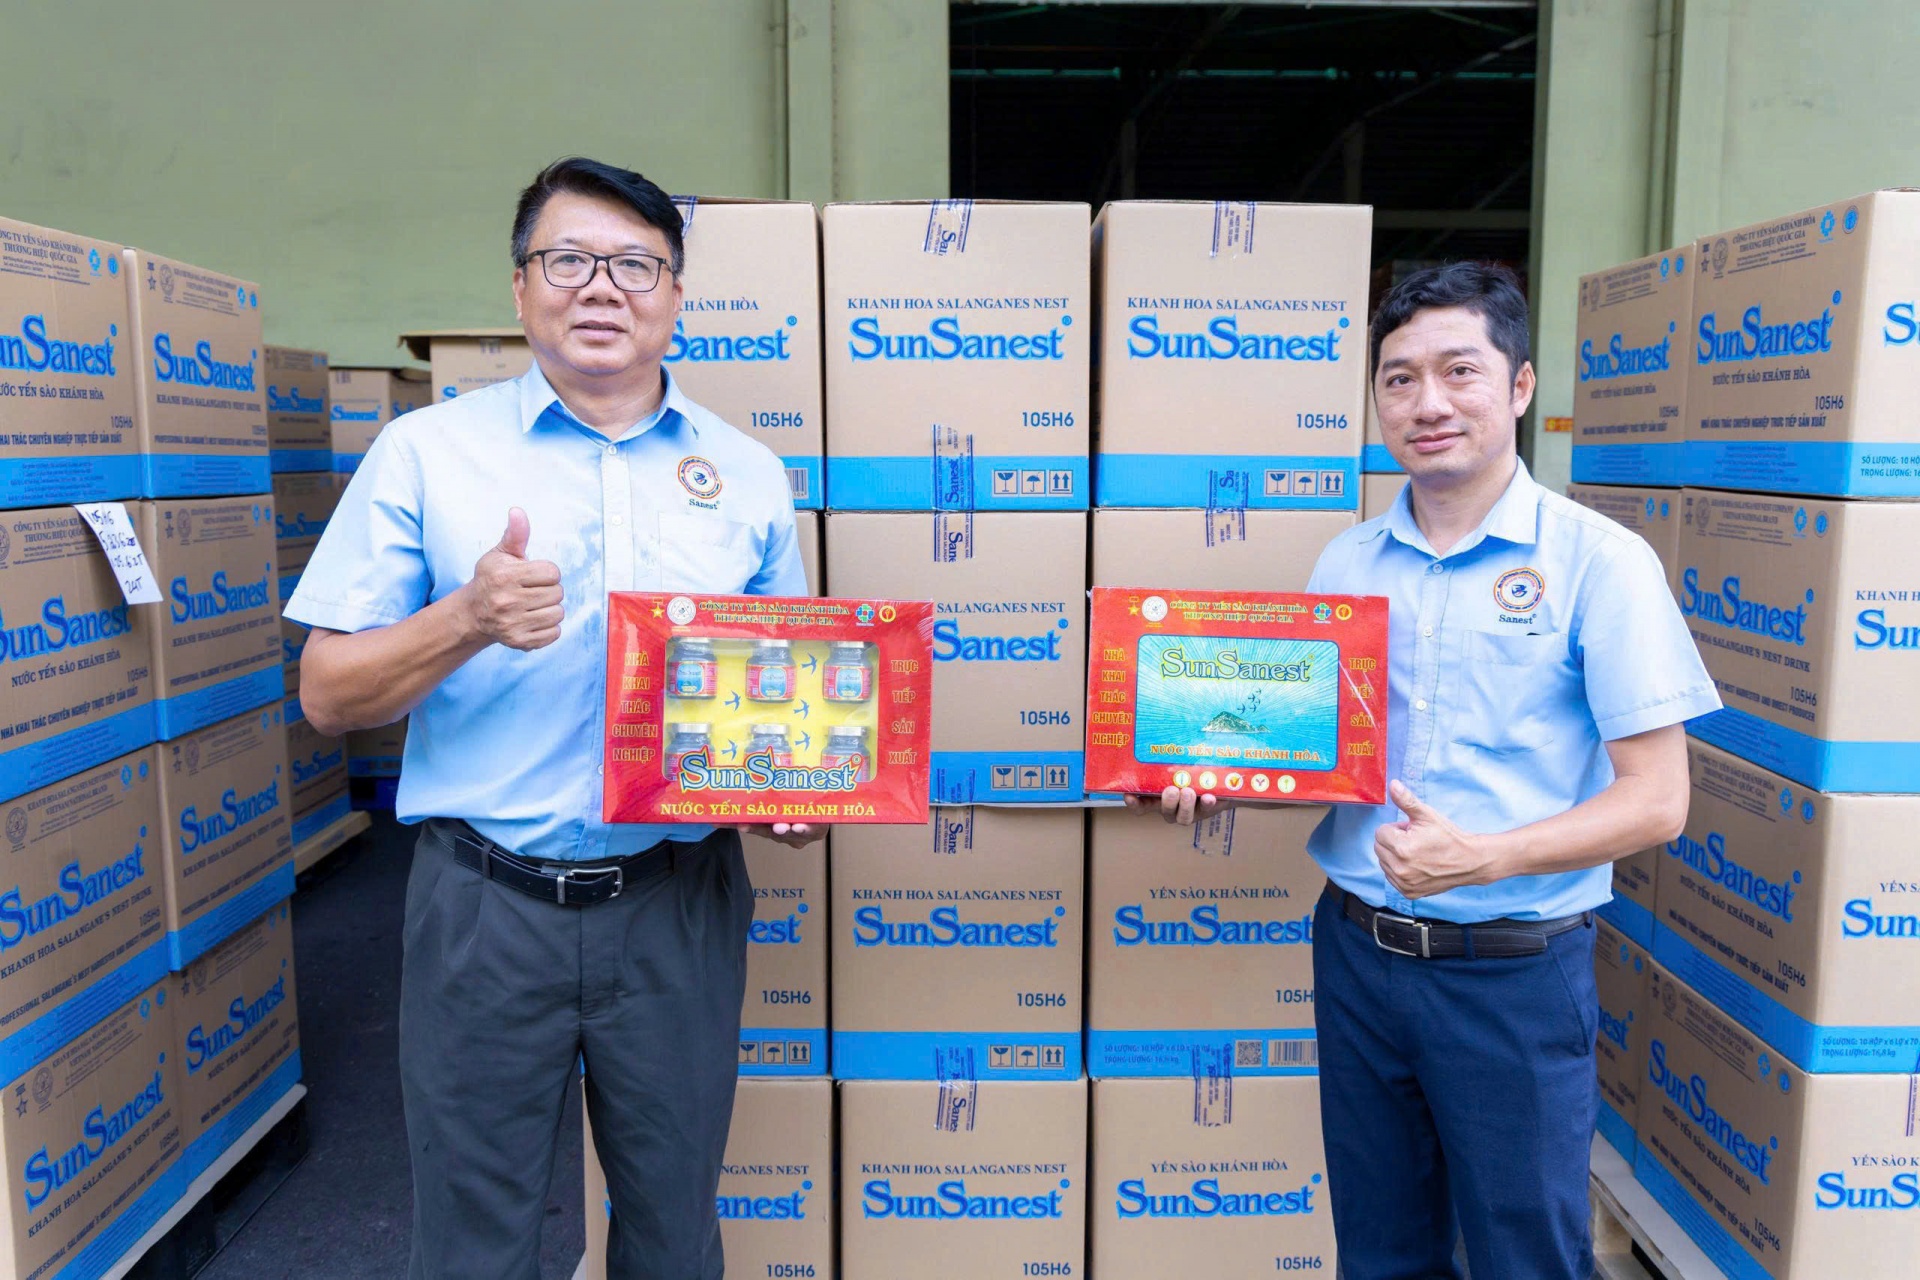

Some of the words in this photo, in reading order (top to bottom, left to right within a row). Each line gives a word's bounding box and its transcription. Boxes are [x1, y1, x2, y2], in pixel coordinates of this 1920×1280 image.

[679, 297, 726, 311] HÁNH
[730, 297, 759, 310] HÒA
[848, 298, 900, 310] KHANH
[904, 299, 933, 310] HOA
[937, 299, 1030, 310] SALANGANES
[1033, 298, 1070, 309] NEST
[1127, 297, 1180, 309] KHANH
[1183, 299, 1213, 310] HOA
[1216, 299, 1308, 311] SALANGANES
[1311, 300, 1348, 311] NEST
[848, 314, 1065, 363] SunSanest
[1127, 312, 1342, 362] SunSanest
[1698, 302, 1834, 365] SunSanest
[1815, 395, 1845, 410] 105H6
[751, 412, 804, 428] 105H6
[1022, 412, 1074, 427] 105H6
[1296, 414, 1348, 429] 105H6
[1856, 590, 1908, 602] KHANH
[936, 602, 1028, 614] SALANGANES
[1030, 602, 1066, 613] NEST
[1498, 614, 1533, 624] Sanest
[0, 594, 132, 664] unSanest
[1162, 645, 1311, 683] SunSanest
[622, 676, 650, 690] KHAI
[1102, 670, 1126, 682] KHAI
[1100, 690, 1126, 703] THÁC
[1790, 686, 1818, 707] 105H6
[1020, 710, 1070, 726] 105H6
[1092, 712, 1132, 724] CHUYÊN
[612, 722, 658, 737] CHUYÊN
[680, 746, 858, 794] SunSanest
[660, 802, 708, 816] NƯỚC
[709, 799, 742, 816] YẾN
[746, 800, 777, 816] SÀO
[782, 800, 839, 816] KHÁNH
[843, 800, 876, 816] HÒA
[770, 888, 806, 898] NEST
[852, 889, 902, 900] KHANH
[906, 890, 934, 900] HOA
[937, 890, 1026, 900] SALANGANES
[1028, 890, 1062, 900] NEST
[1150, 886, 1177, 899] YẾN
[1180, 886, 1206, 899] SÀO
[1209, 886, 1260, 898] KHÁNH
[1262, 885, 1290, 898] HÒA
[1880, 881, 1908, 893] YẾN
[853, 903, 1059, 948] SunSanest
[1841, 897, 1920, 940] Sun
[1778, 960, 1806, 988] 105H6
[762, 990, 812, 1004] 105H6
[1017, 992, 1066, 1007] 105H6
[1150, 1160, 1178, 1174] YẾN
[1180, 1160, 1206, 1174] SÀO
[1209, 1159, 1258, 1172] KHÁNH
[1262, 1158, 1288, 1172] HÒA
[1852, 1154, 1879, 1166] YẾN
[1882, 1154, 1907, 1167] SÀO
[776, 1165, 810, 1175] NEST
[862, 1163, 910, 1174] KHANH
[914, 1164, 942, 1174] HOA
[944, 1164, 1031, 1175] SALANGANES
[1034, 1164, 1068, 1174] NEST
[862, 1178, 1064, 1220] SunSanest
[1116, 1176, 1314, 1220] SunSanest
[1754, 1217, 1781, 1251] 105H6
[1023, 1262, 1072, 1276] 105H6
[1275, 1256, 1322, 1270] 105H6
[766, 1264, 815, 1278] 105H6
